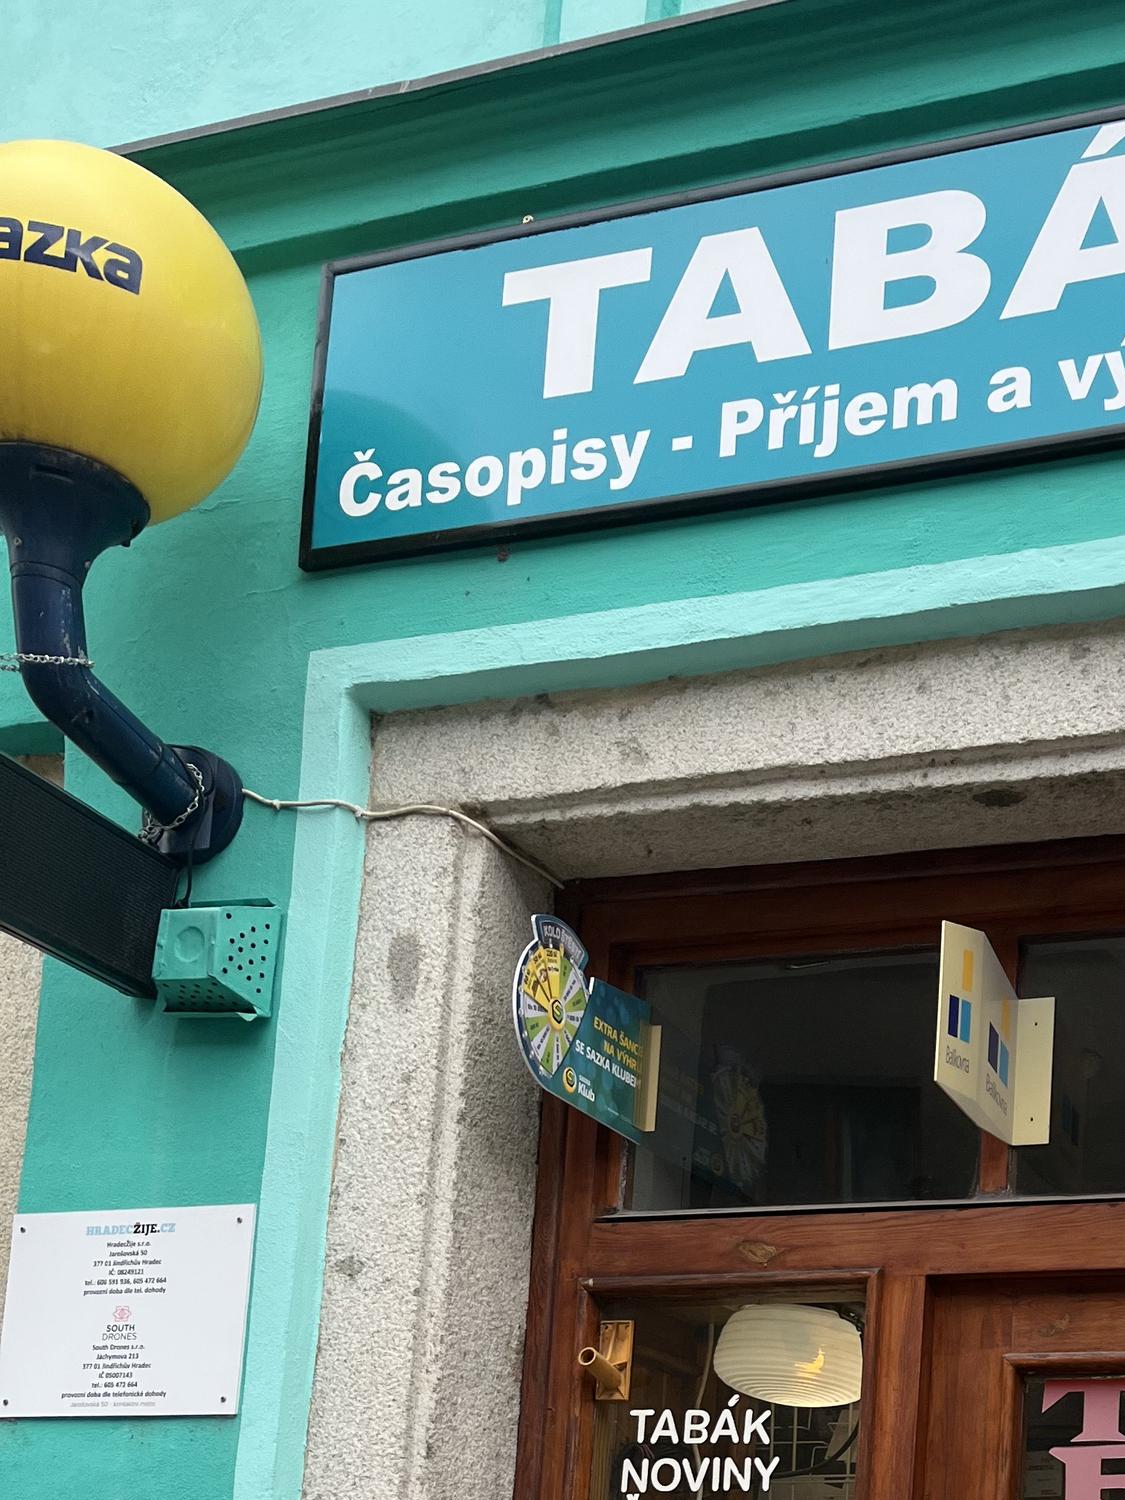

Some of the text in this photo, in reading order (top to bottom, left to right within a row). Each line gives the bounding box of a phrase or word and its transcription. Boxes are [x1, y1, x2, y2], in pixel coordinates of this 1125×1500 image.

[339, 431, 650, 519] Časopisy
[672, 437, 693, 452] -
[719, 380, 957, 458] Příjem
[989, 367, 1031, 414] a
[575, 1039, 586, 1056] SE
[586, 1046, 611, 1072] SAZKA
[86, 1222, 176, 1236] HRADECŽIJE.CZ
[101, 1332, 137, 1341] DRONES
[106, 1324, 135, 1333] SOUTH
[629, 1394, 772, 1445] TABÁK
[620, 1456, 780, 1493] NOVINY
